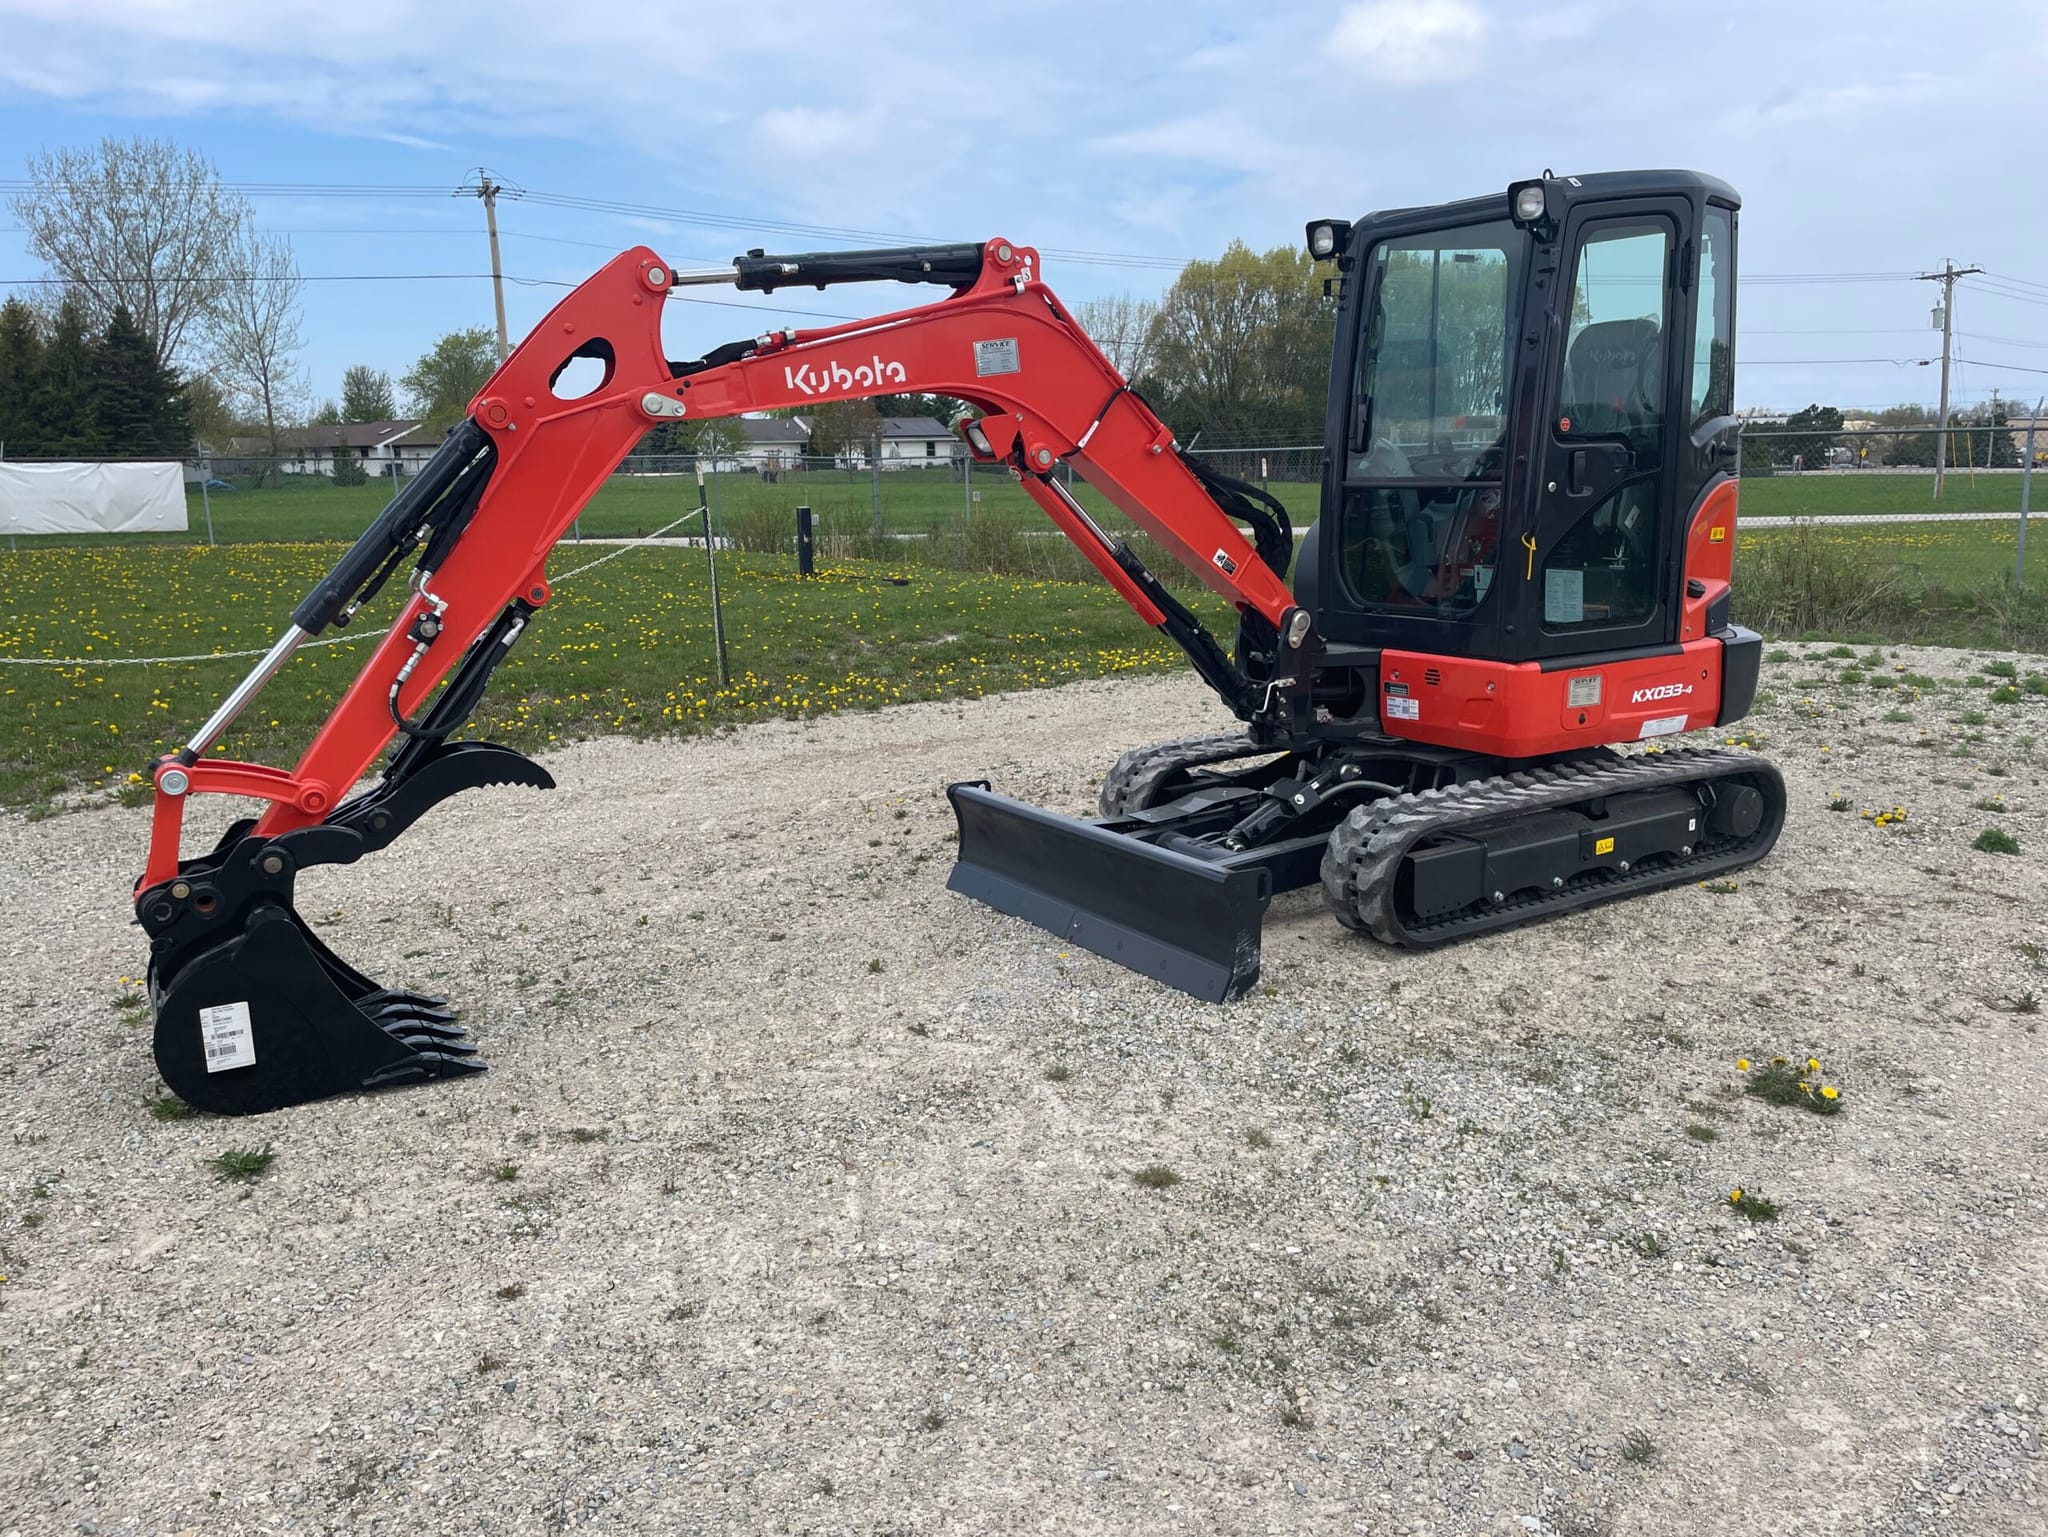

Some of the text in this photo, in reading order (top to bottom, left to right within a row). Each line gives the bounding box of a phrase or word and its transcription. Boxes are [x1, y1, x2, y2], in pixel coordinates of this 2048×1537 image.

[981, 341, 1010, 349] SERVICE
[784, 355, 907, 395] Kubota
[1631, 682, 1694, 704] KX033-4
